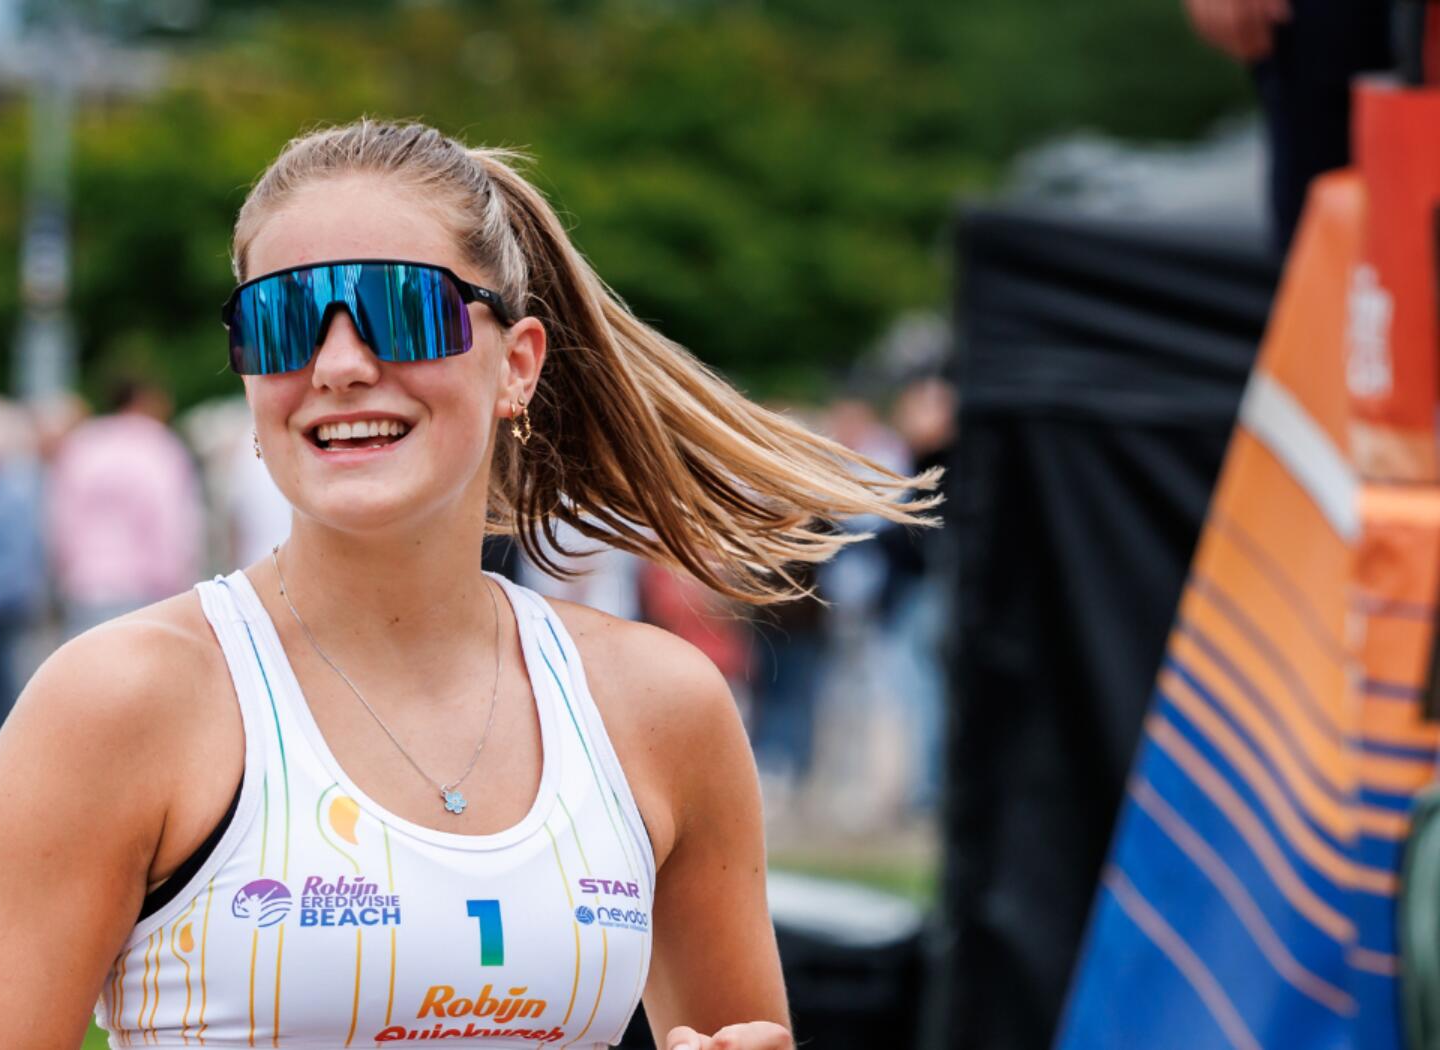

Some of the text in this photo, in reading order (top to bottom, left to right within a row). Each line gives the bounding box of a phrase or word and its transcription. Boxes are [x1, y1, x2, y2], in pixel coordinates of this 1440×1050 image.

[302, 875, 378, 898] Robijn
[579, 879, 640, 899] STAR
[301, 895, 400, 908] EREDIVISIE
[300, 908, 401, 927] BEACH
[466, 900, 504, 966] 1
[416, 984, 547, 1024] Robijn
